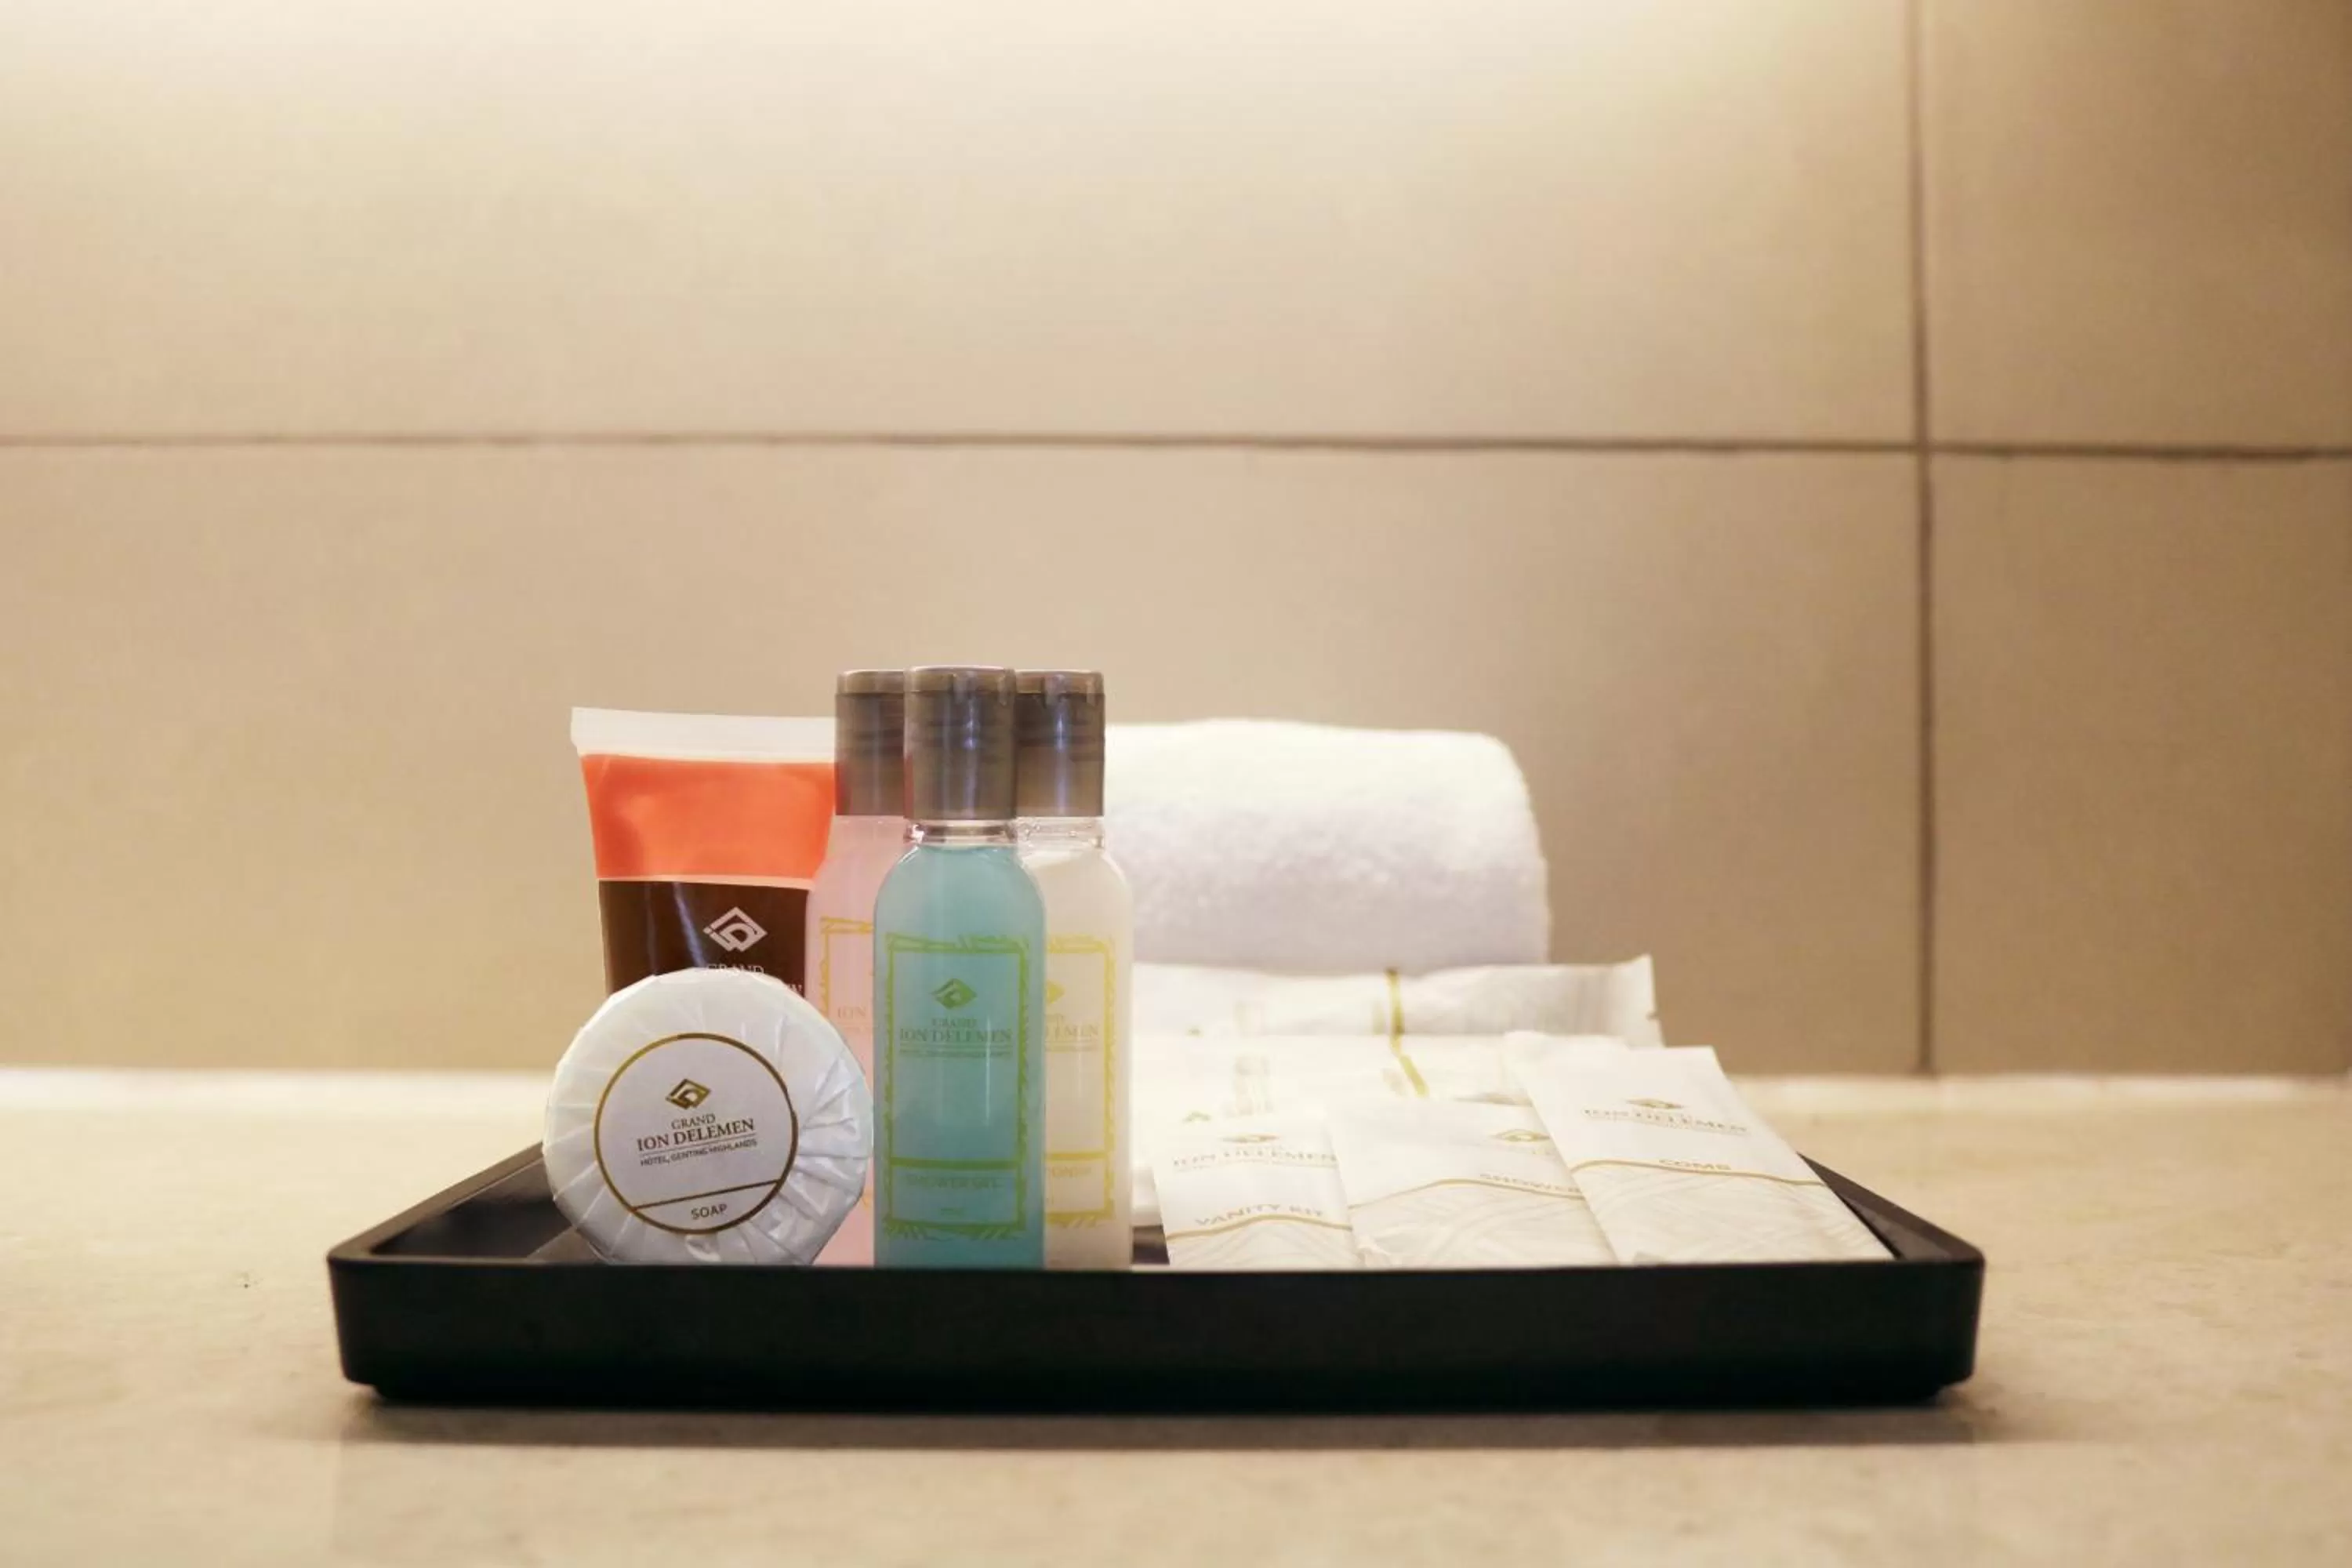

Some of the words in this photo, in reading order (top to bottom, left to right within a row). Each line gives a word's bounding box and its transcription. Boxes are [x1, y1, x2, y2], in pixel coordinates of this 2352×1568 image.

[899, 1028, 928, 1042] ION
[671, 1112, 716, 1131] GRAND
[637, 1133, 670, 1152] ION
[673, 1118, 755, 1145] DELEMEN
[670, 1148, 709, 1162] GENTING
[709, 1138, 757, 1156] HIGHLANDS
[691, 1203, 728, 1221] SOAP
[1194, 1203, 1281, 1226] VANITY
[1287, 1203, 1323, 1218] KIT
